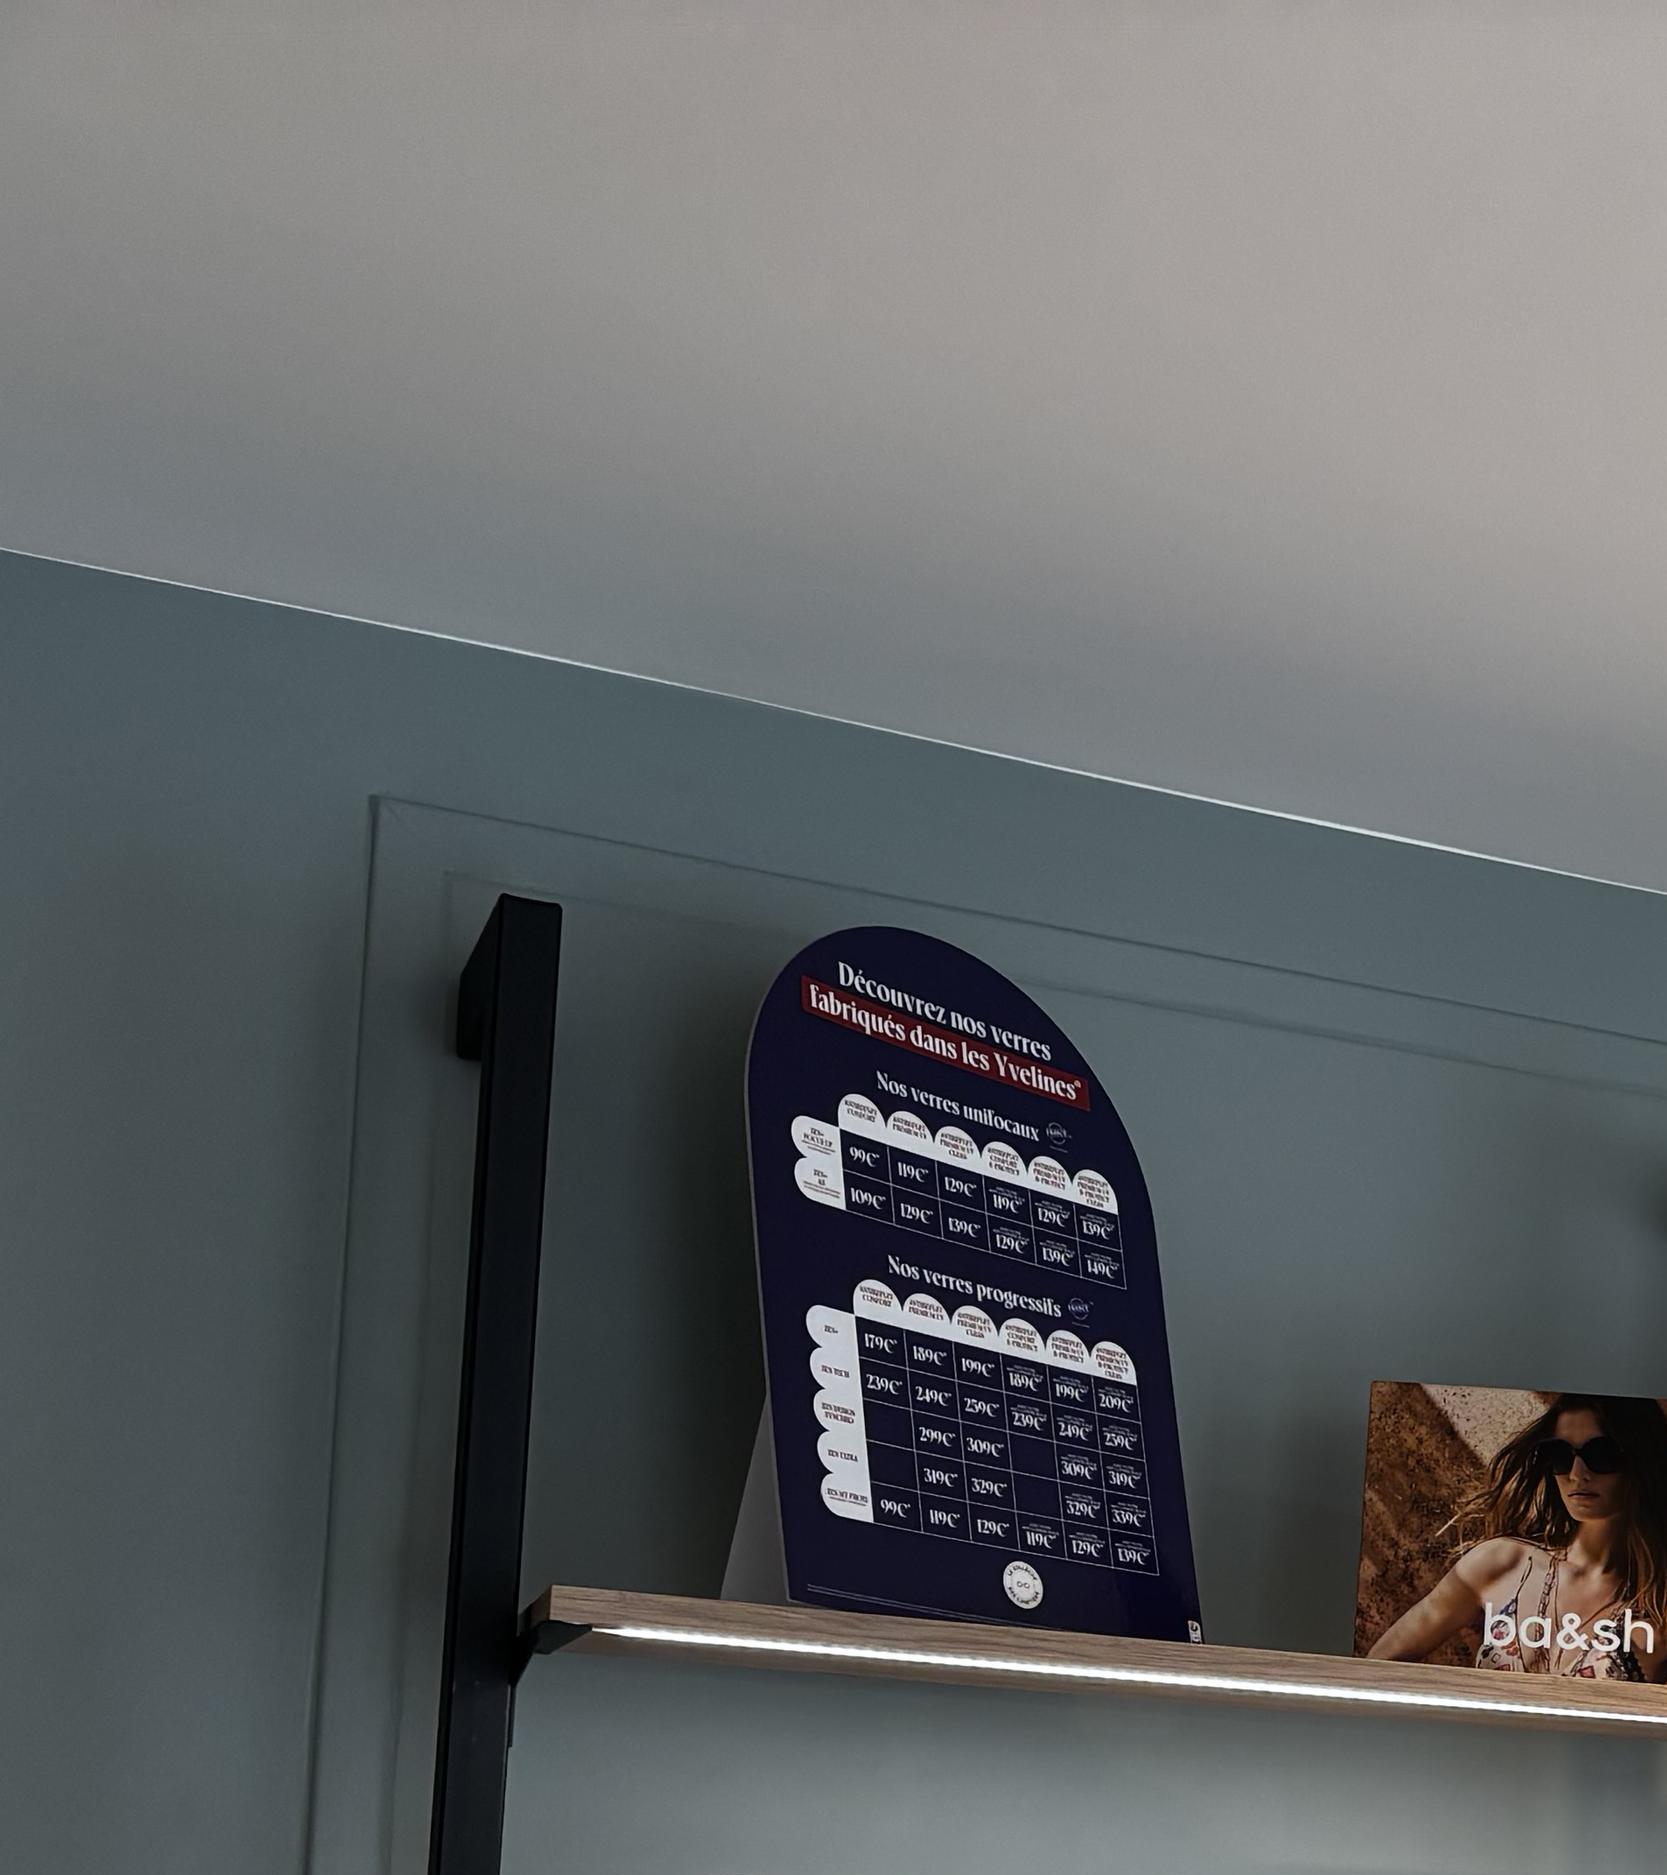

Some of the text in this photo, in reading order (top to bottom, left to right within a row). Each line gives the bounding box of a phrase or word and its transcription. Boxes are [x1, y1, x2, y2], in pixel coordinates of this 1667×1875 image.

[809, 984, 906, 1042] fabriqués
[910, 1025, 957, 1059] dans
[962, 1042, 990, 1071] les
[838, 961, 1052, 1061] Découvrez nos verres
[876, 1070, 908, 1098] Nos
[910, 1087, 960, 1116] verres
[963, 1106, 1039, 1142] unifocaux
[888, 1254, 920, 1280] Nos
[922, 1269, 973, 1294] verres
[976, 1283, 1062, 1318] progressifs
[1483, 1602, 1655, 1654] ba&sh
